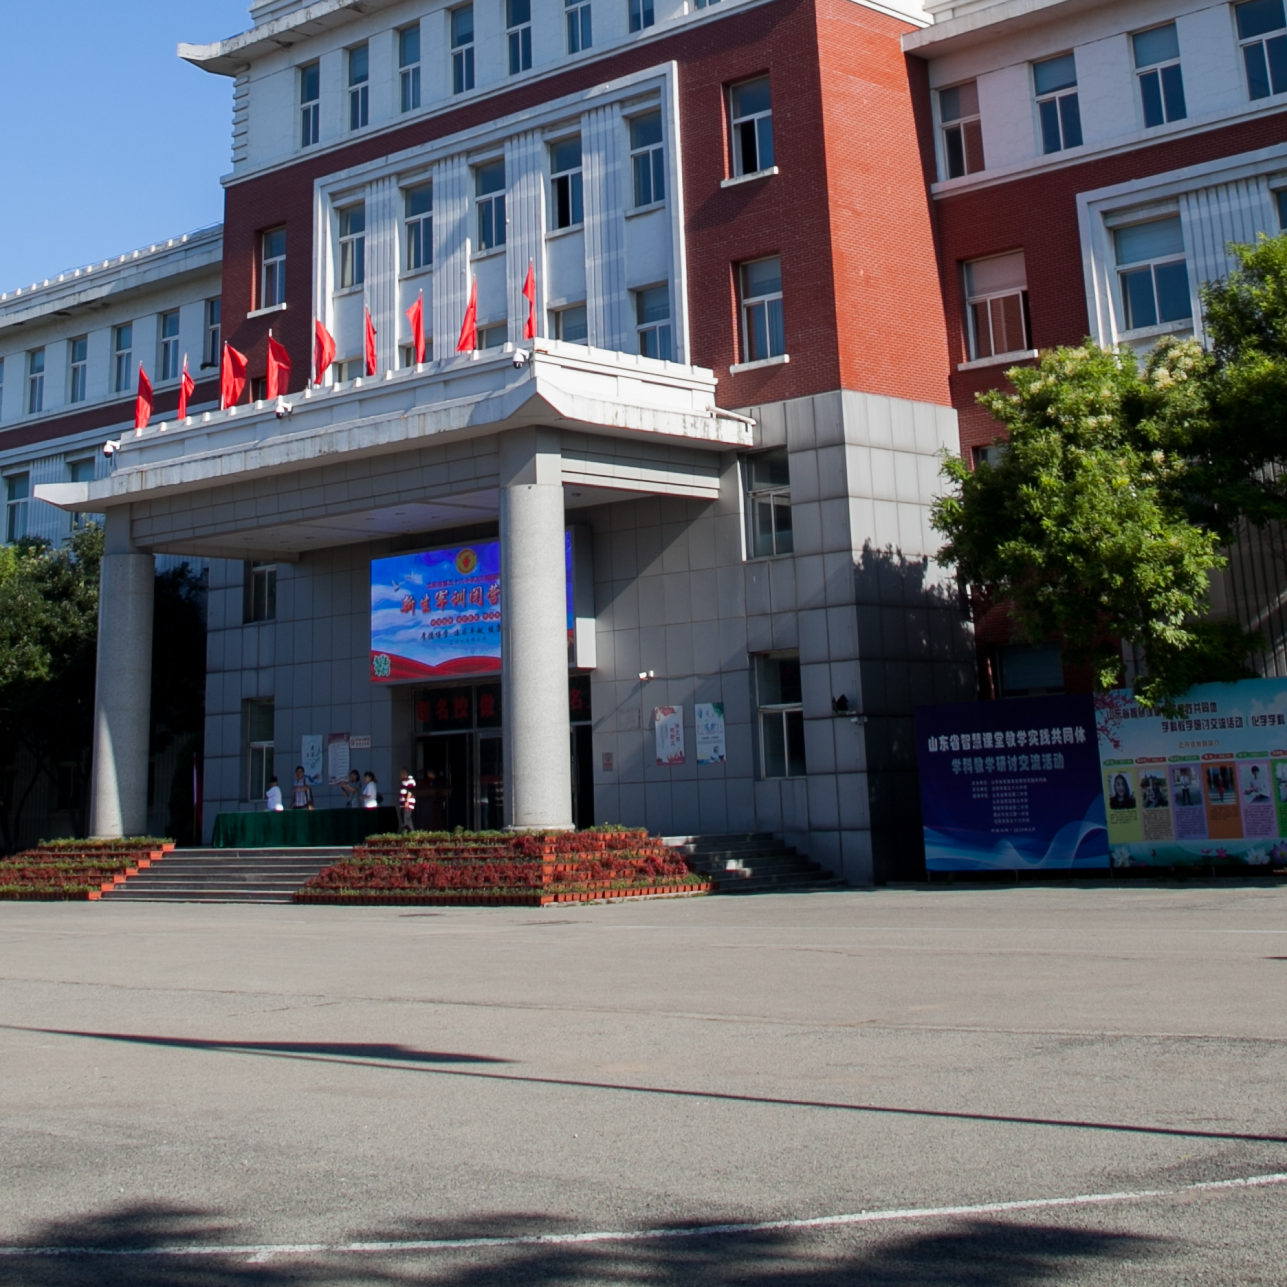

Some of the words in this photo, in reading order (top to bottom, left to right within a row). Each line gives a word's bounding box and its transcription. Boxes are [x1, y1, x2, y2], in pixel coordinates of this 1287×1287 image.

[1106, 701, 1218, 721] 山东省智慧课堂实践共同体
[927, 725, 1087, 753] 山东省智慧课堂教学实践共同体
[950, 751, 1065, 775] 学科教学研讨交流活动
